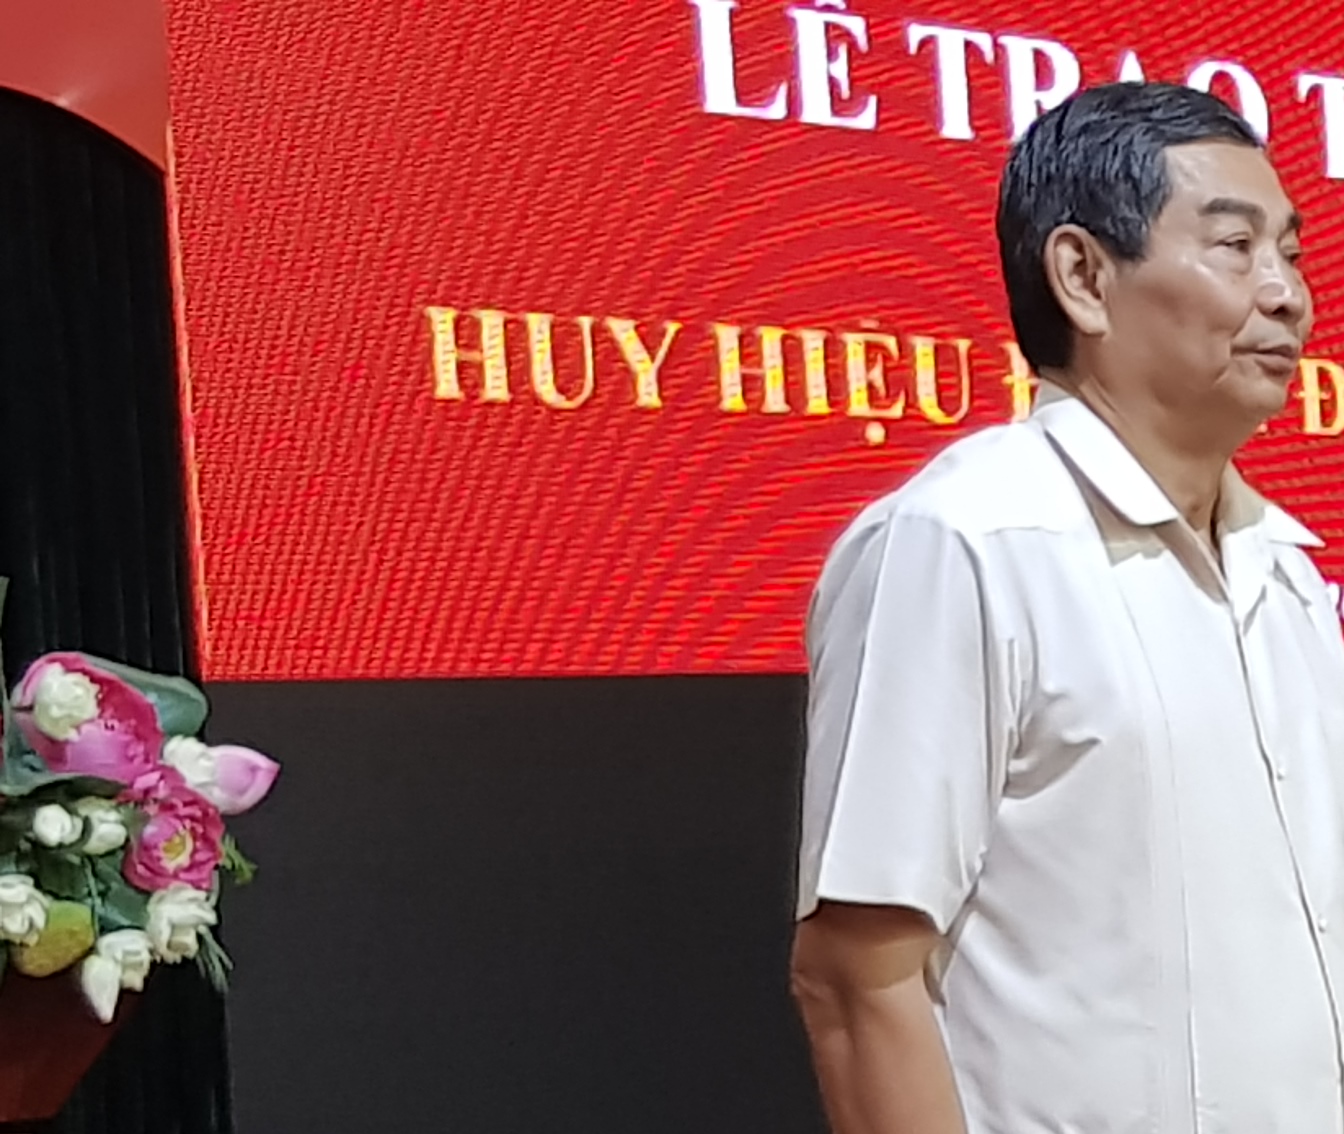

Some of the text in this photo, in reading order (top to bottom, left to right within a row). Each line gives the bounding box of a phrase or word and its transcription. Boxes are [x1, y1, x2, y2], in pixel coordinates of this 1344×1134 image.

[905, 20, 1269, 147] TRO
[423, 305, 684, 410] HUY
[712, 318, 974, 447] HIỆU
